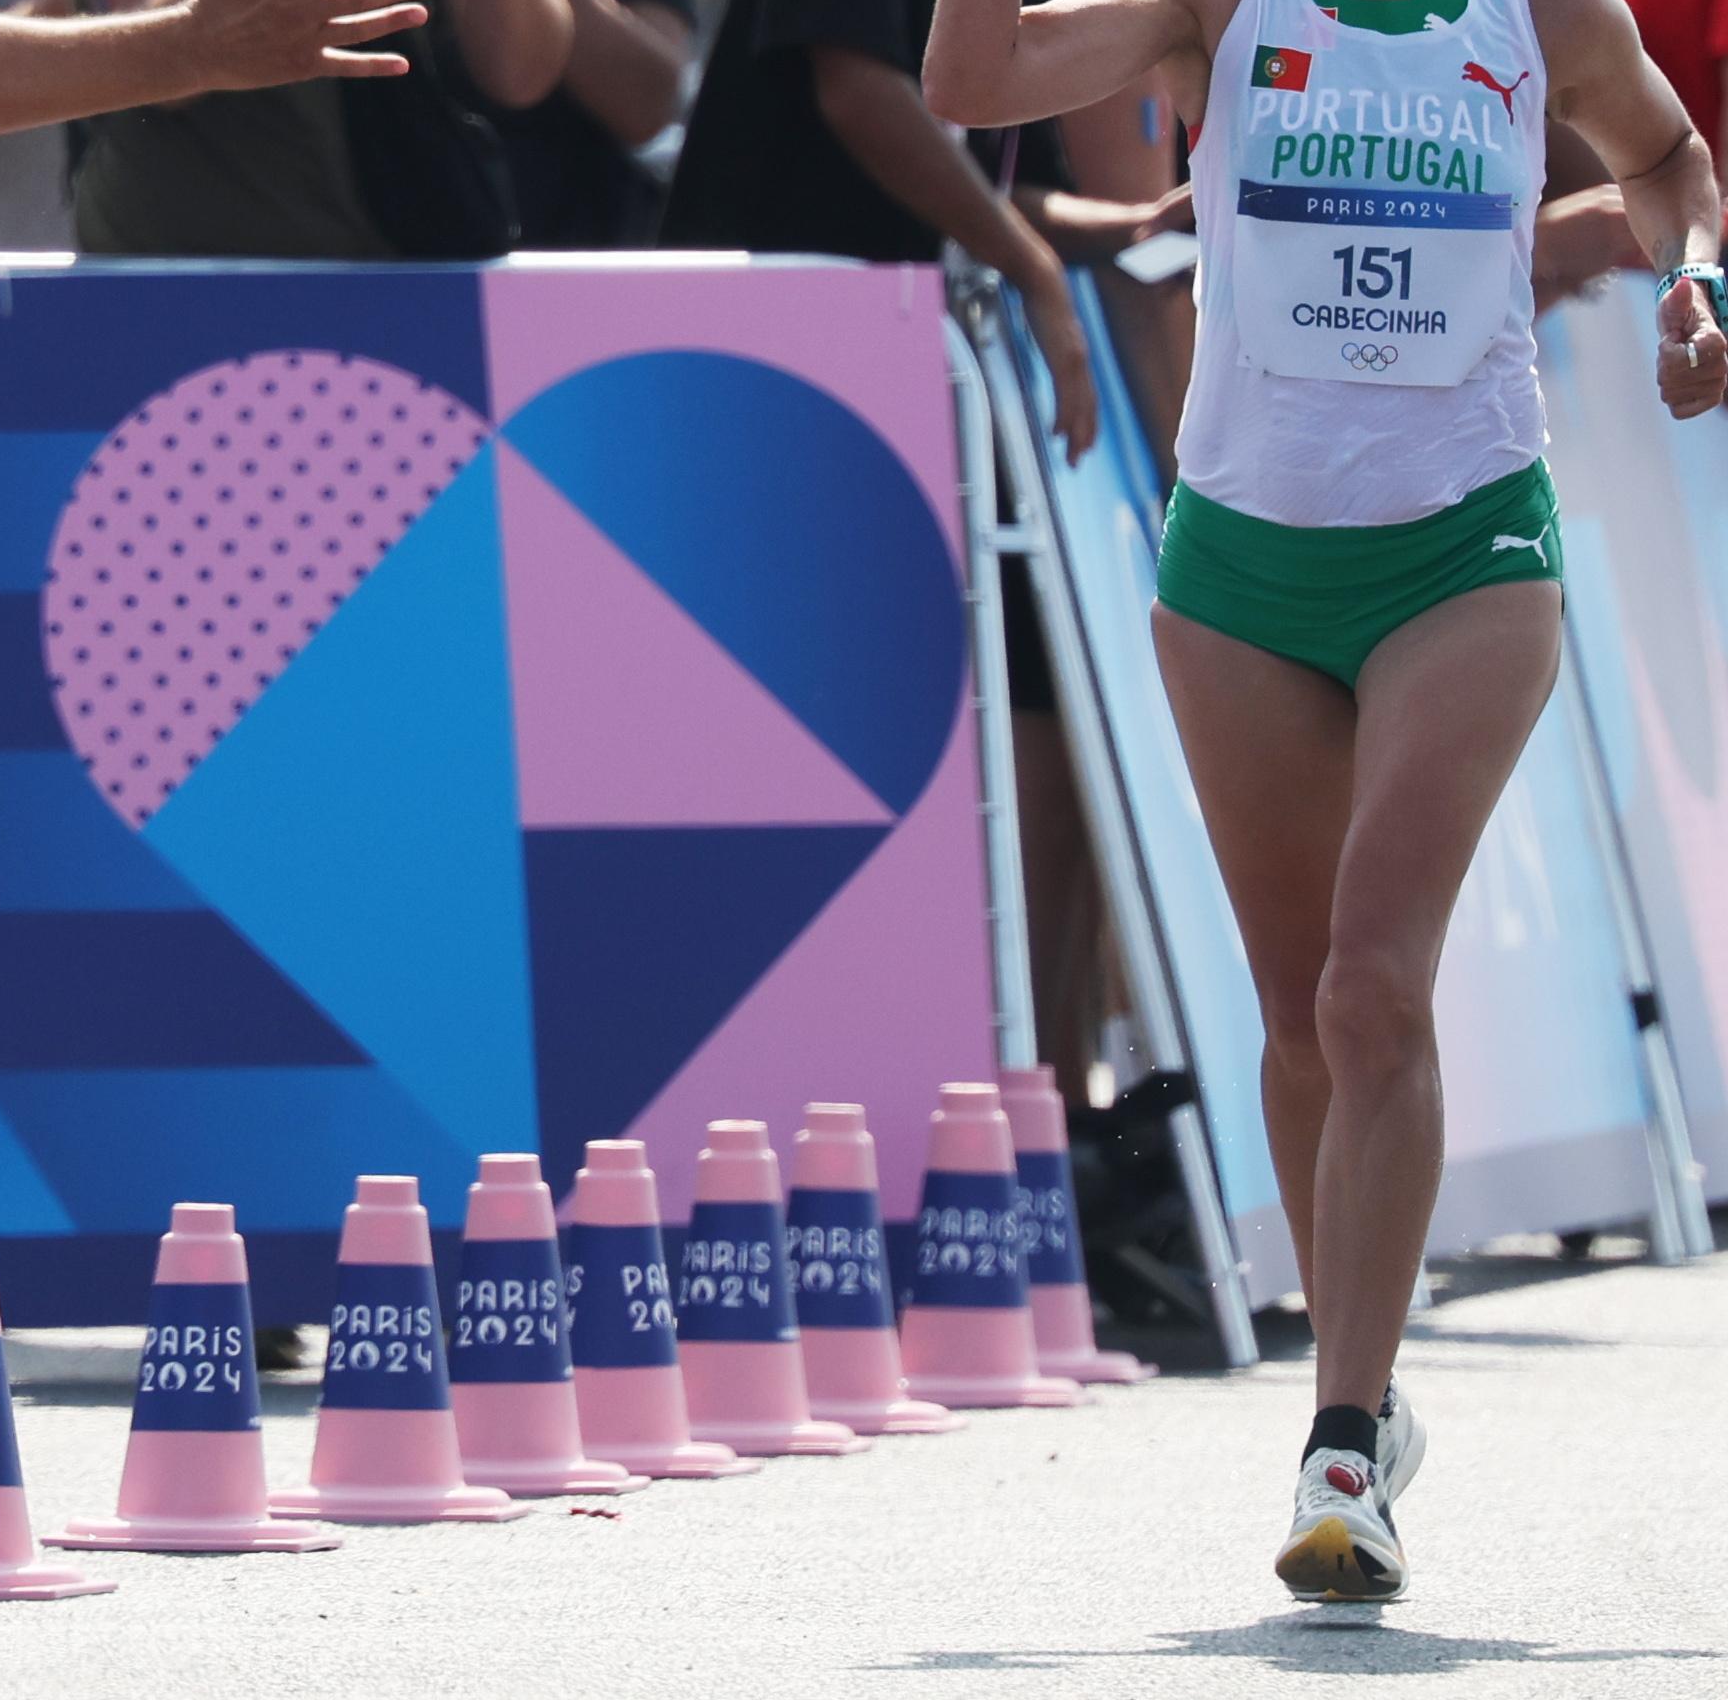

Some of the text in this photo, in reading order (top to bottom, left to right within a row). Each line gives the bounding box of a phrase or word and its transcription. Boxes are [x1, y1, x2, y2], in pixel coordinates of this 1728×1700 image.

[1248, 87, 1503, 151] PORTUGAL
[1271, 132, 1490, 194] PORTUGAL
[1384, 200, 1446, 219] 2024
[1333, 244, 1412, 300] 151
[1292, 303, 1447, 334] CABECINHA
[456, 1314, 558, 1346] 2024
[329, 1339, 432, 1373] 2024
[140, 1360, 241, 1393] 2024
